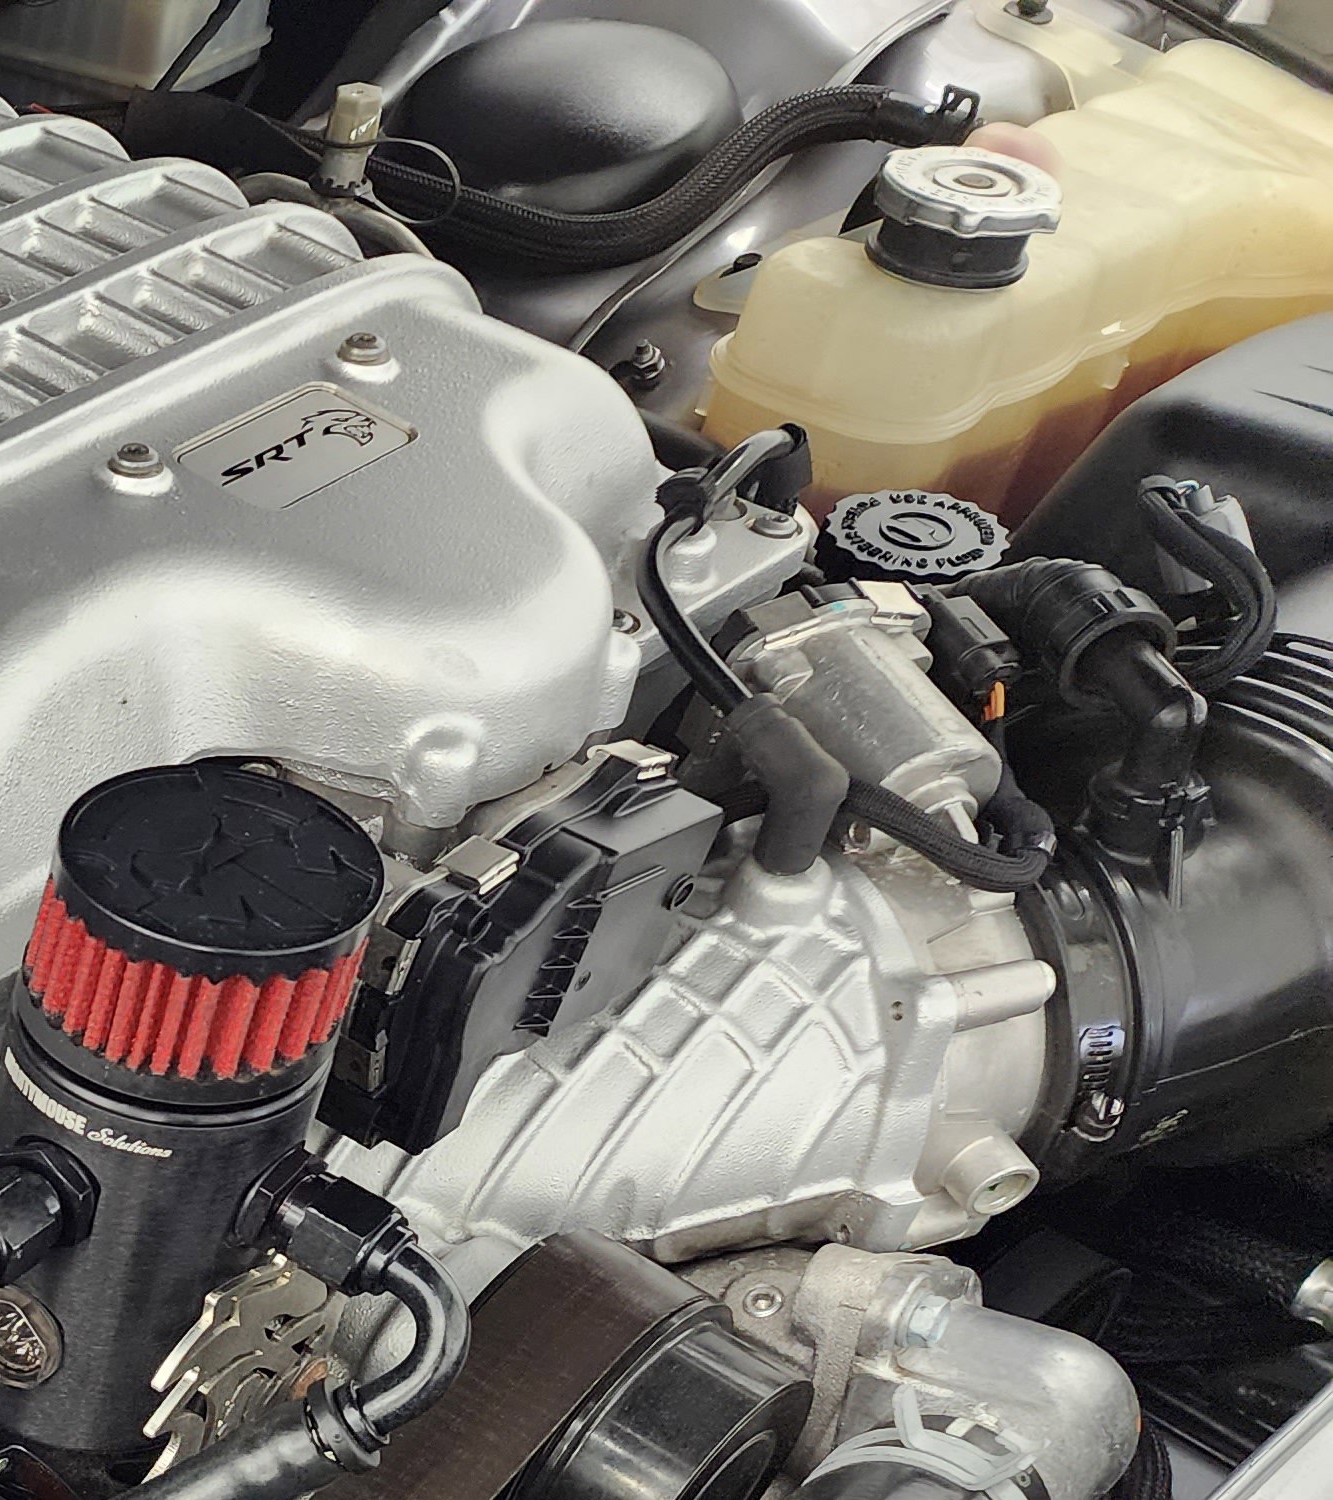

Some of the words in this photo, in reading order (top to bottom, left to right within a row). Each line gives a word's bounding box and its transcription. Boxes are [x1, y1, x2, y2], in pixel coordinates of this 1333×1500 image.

[221, 426, 314, 487] SRT
[4, 1046, 88, 1136] TYMOUSE
[86, 1127, 173, 1158] Solutions
